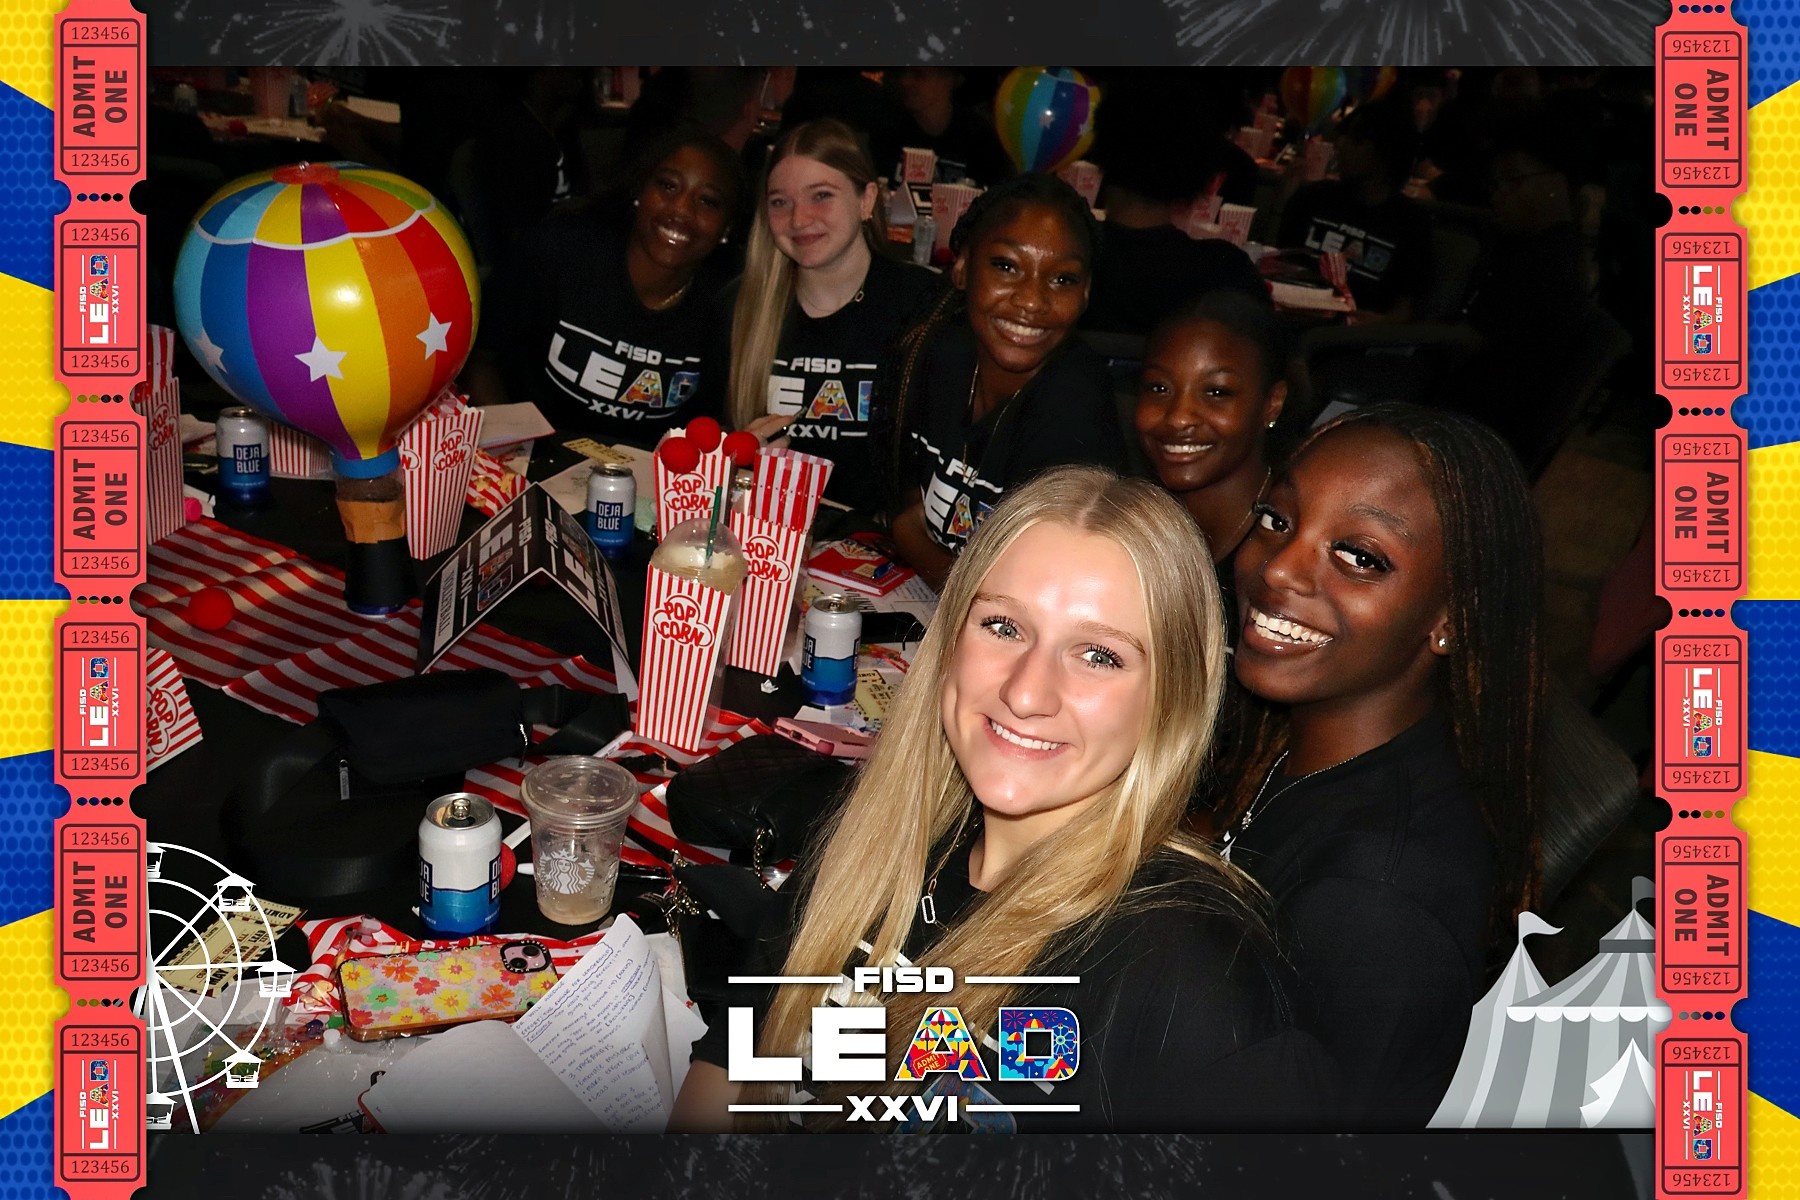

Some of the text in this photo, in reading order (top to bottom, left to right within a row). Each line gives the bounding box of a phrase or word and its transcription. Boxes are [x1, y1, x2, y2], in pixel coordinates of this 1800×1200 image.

[615, 340, 662, 365] FISD
[548, 332, 700, 408] LEAD
[790, 357, 841, 373] FISD
[588, 399, 645, 421] XXVI
[236, 446, 260, 460] DEJA
[441, 436, 462, 454] POP
[236, 460, 260, 473] BLUE
[436, 450, 466, 471] CORN
[672, 479, 701, 499] POP
[598, 503, 621, 516] DEJA
[670, 494, 711, 511] CORN
[519, 517, 532, 547] FISD
[597, 517, 620, 530] BLUE
[477, 506, 513, 612] LEAD
[746, 542, 776, 560] POP
[664, 601, 696, 622] POP
[660, 622, 704, 646] CORN
[150, 688, 173, 723] POP
